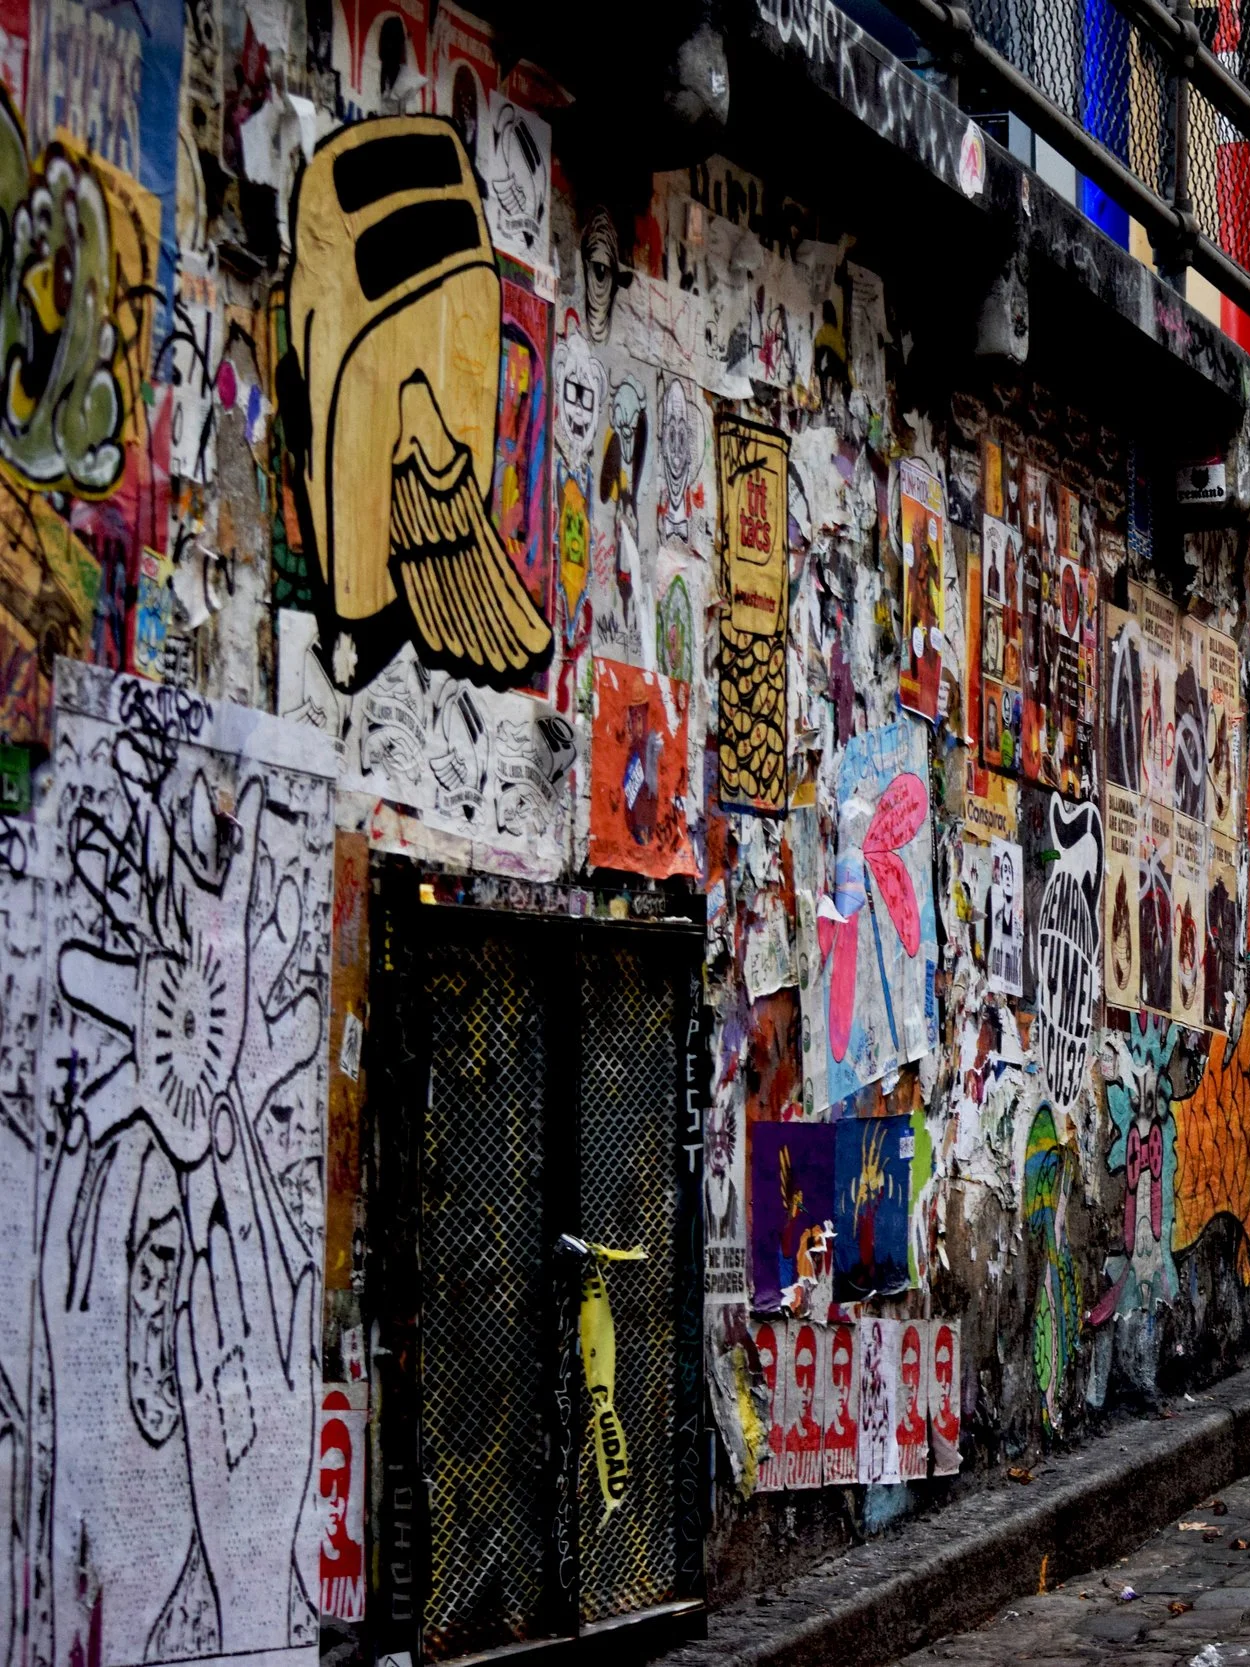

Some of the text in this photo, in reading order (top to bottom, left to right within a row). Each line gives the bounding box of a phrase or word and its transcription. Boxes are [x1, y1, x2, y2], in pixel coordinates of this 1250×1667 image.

[747, 468, 768, 521] tit
[739, 507, 771, 554] tacs
[786, 1451, 822, 1489] RUIN
[322, 1575, 365, 1617] UIN
